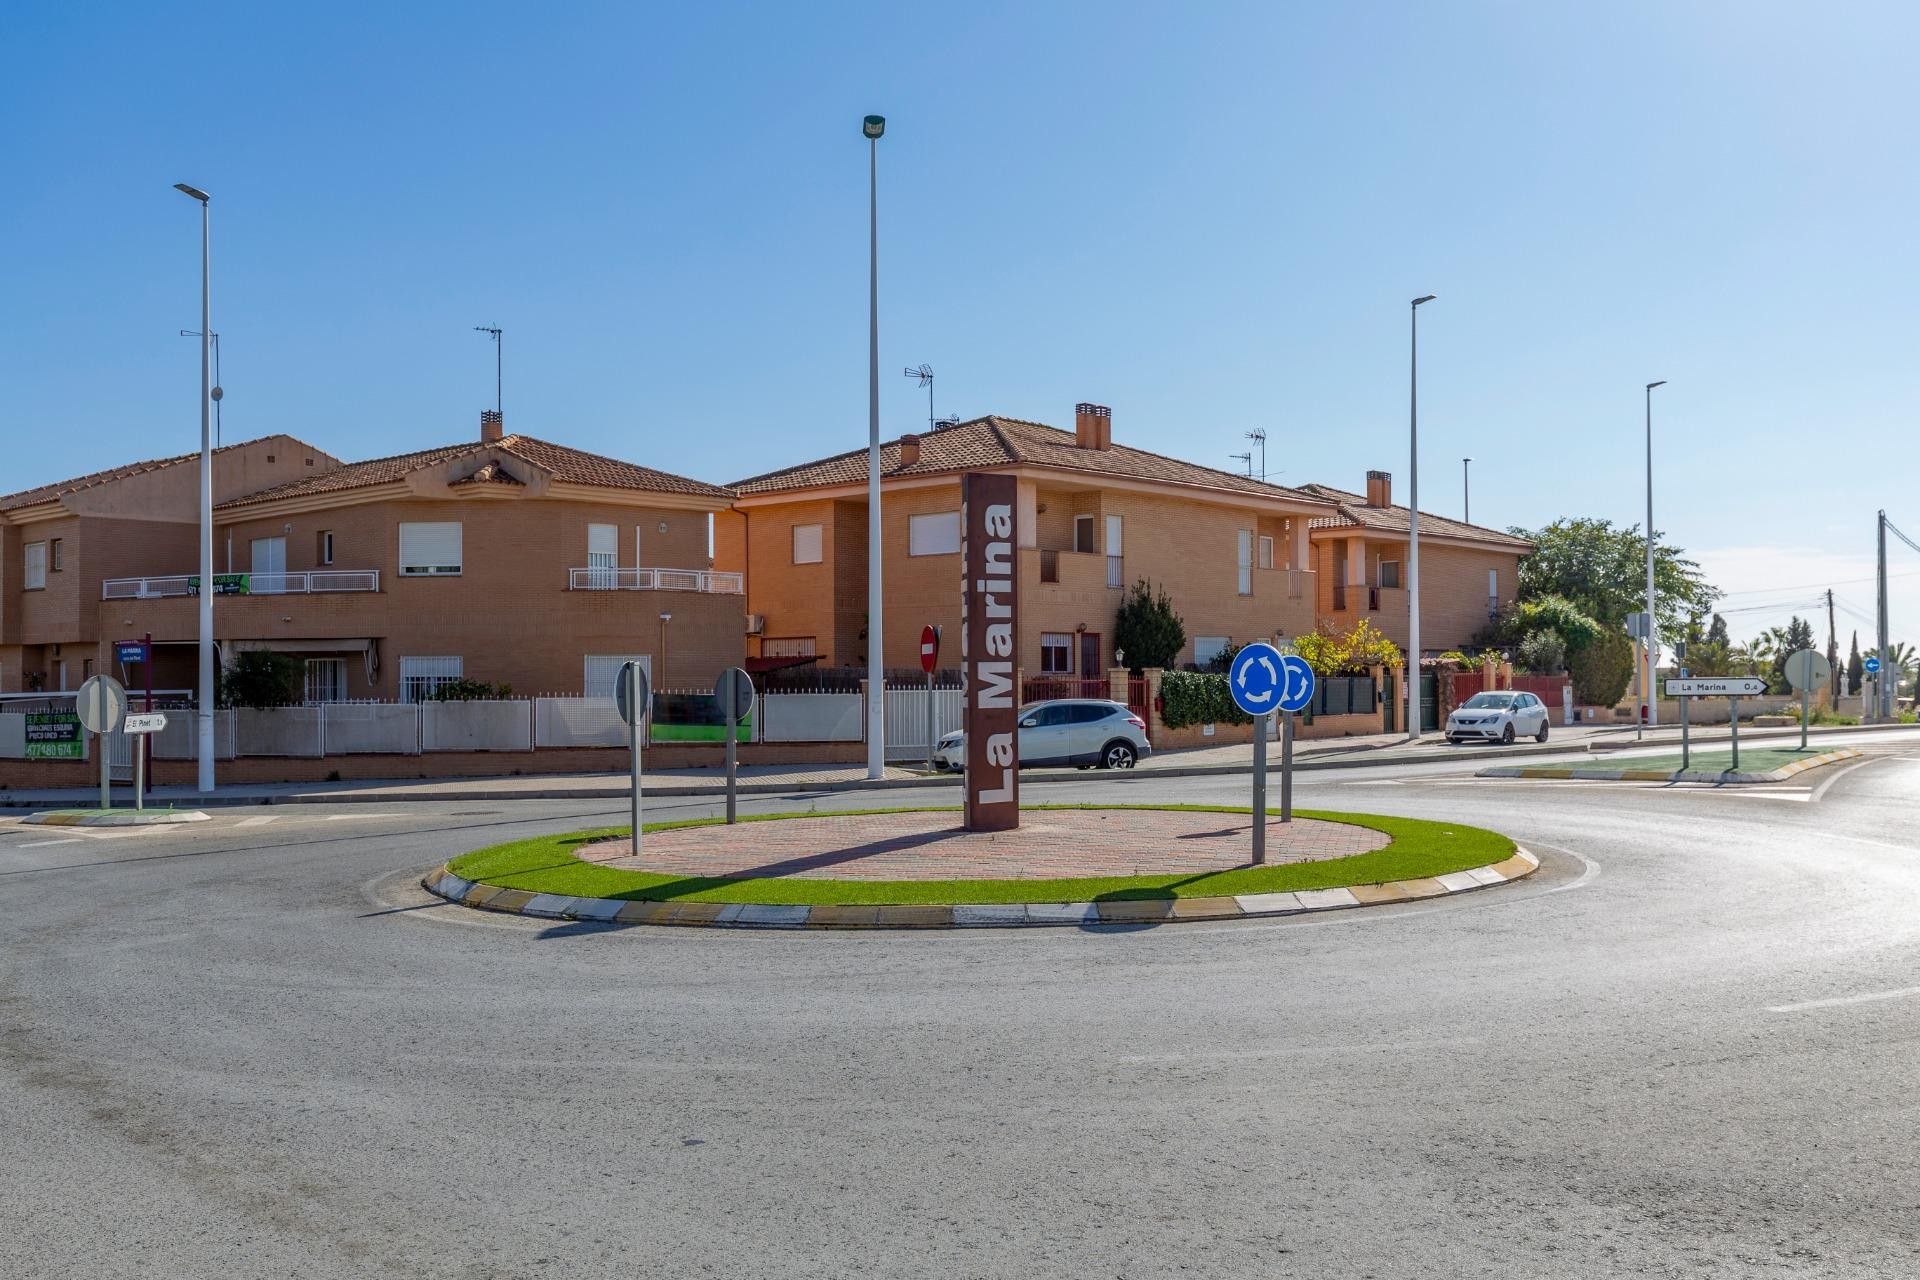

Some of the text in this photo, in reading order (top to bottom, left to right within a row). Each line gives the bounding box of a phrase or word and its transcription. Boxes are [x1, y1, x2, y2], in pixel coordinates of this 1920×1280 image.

[977, 503, 1014, 805] La Marina
[1682, 683, 1692, 691] La
[1697, 683, 1727, 691] Marina
[57, 744, 72, 756] 674
